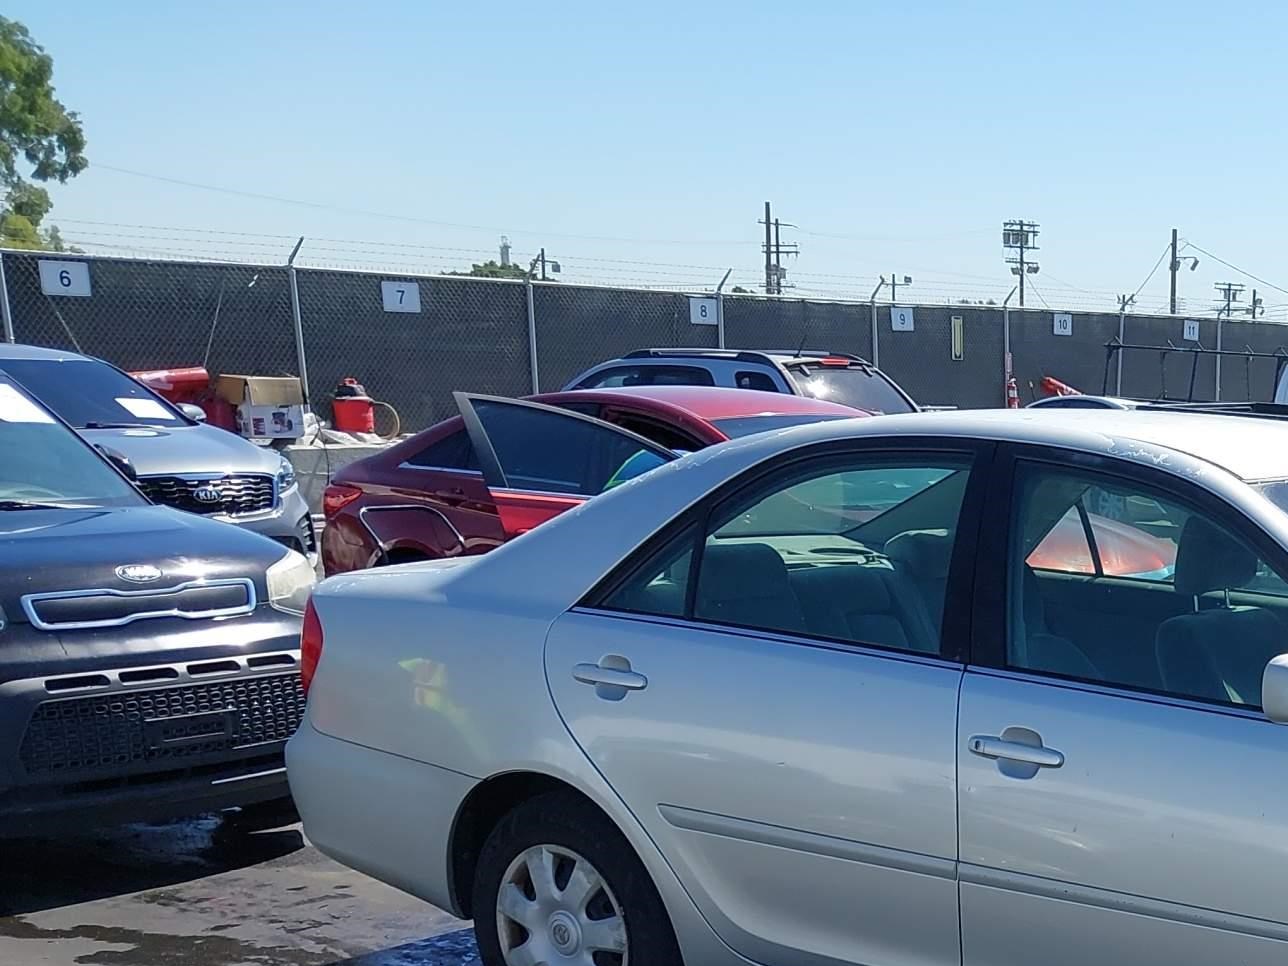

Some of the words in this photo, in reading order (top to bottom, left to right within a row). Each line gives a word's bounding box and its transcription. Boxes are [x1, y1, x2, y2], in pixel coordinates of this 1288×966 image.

[59, 270, 71, 287] 6
[396, 290, 405, 304] 7
[700, 304, 708, 318] 8
[899, 313, 906, 325] 9
[1058, 319, 1068, 330] 10
[1188, 325, 1195, 336] 11
[198, 490, 219, 500] KIA
